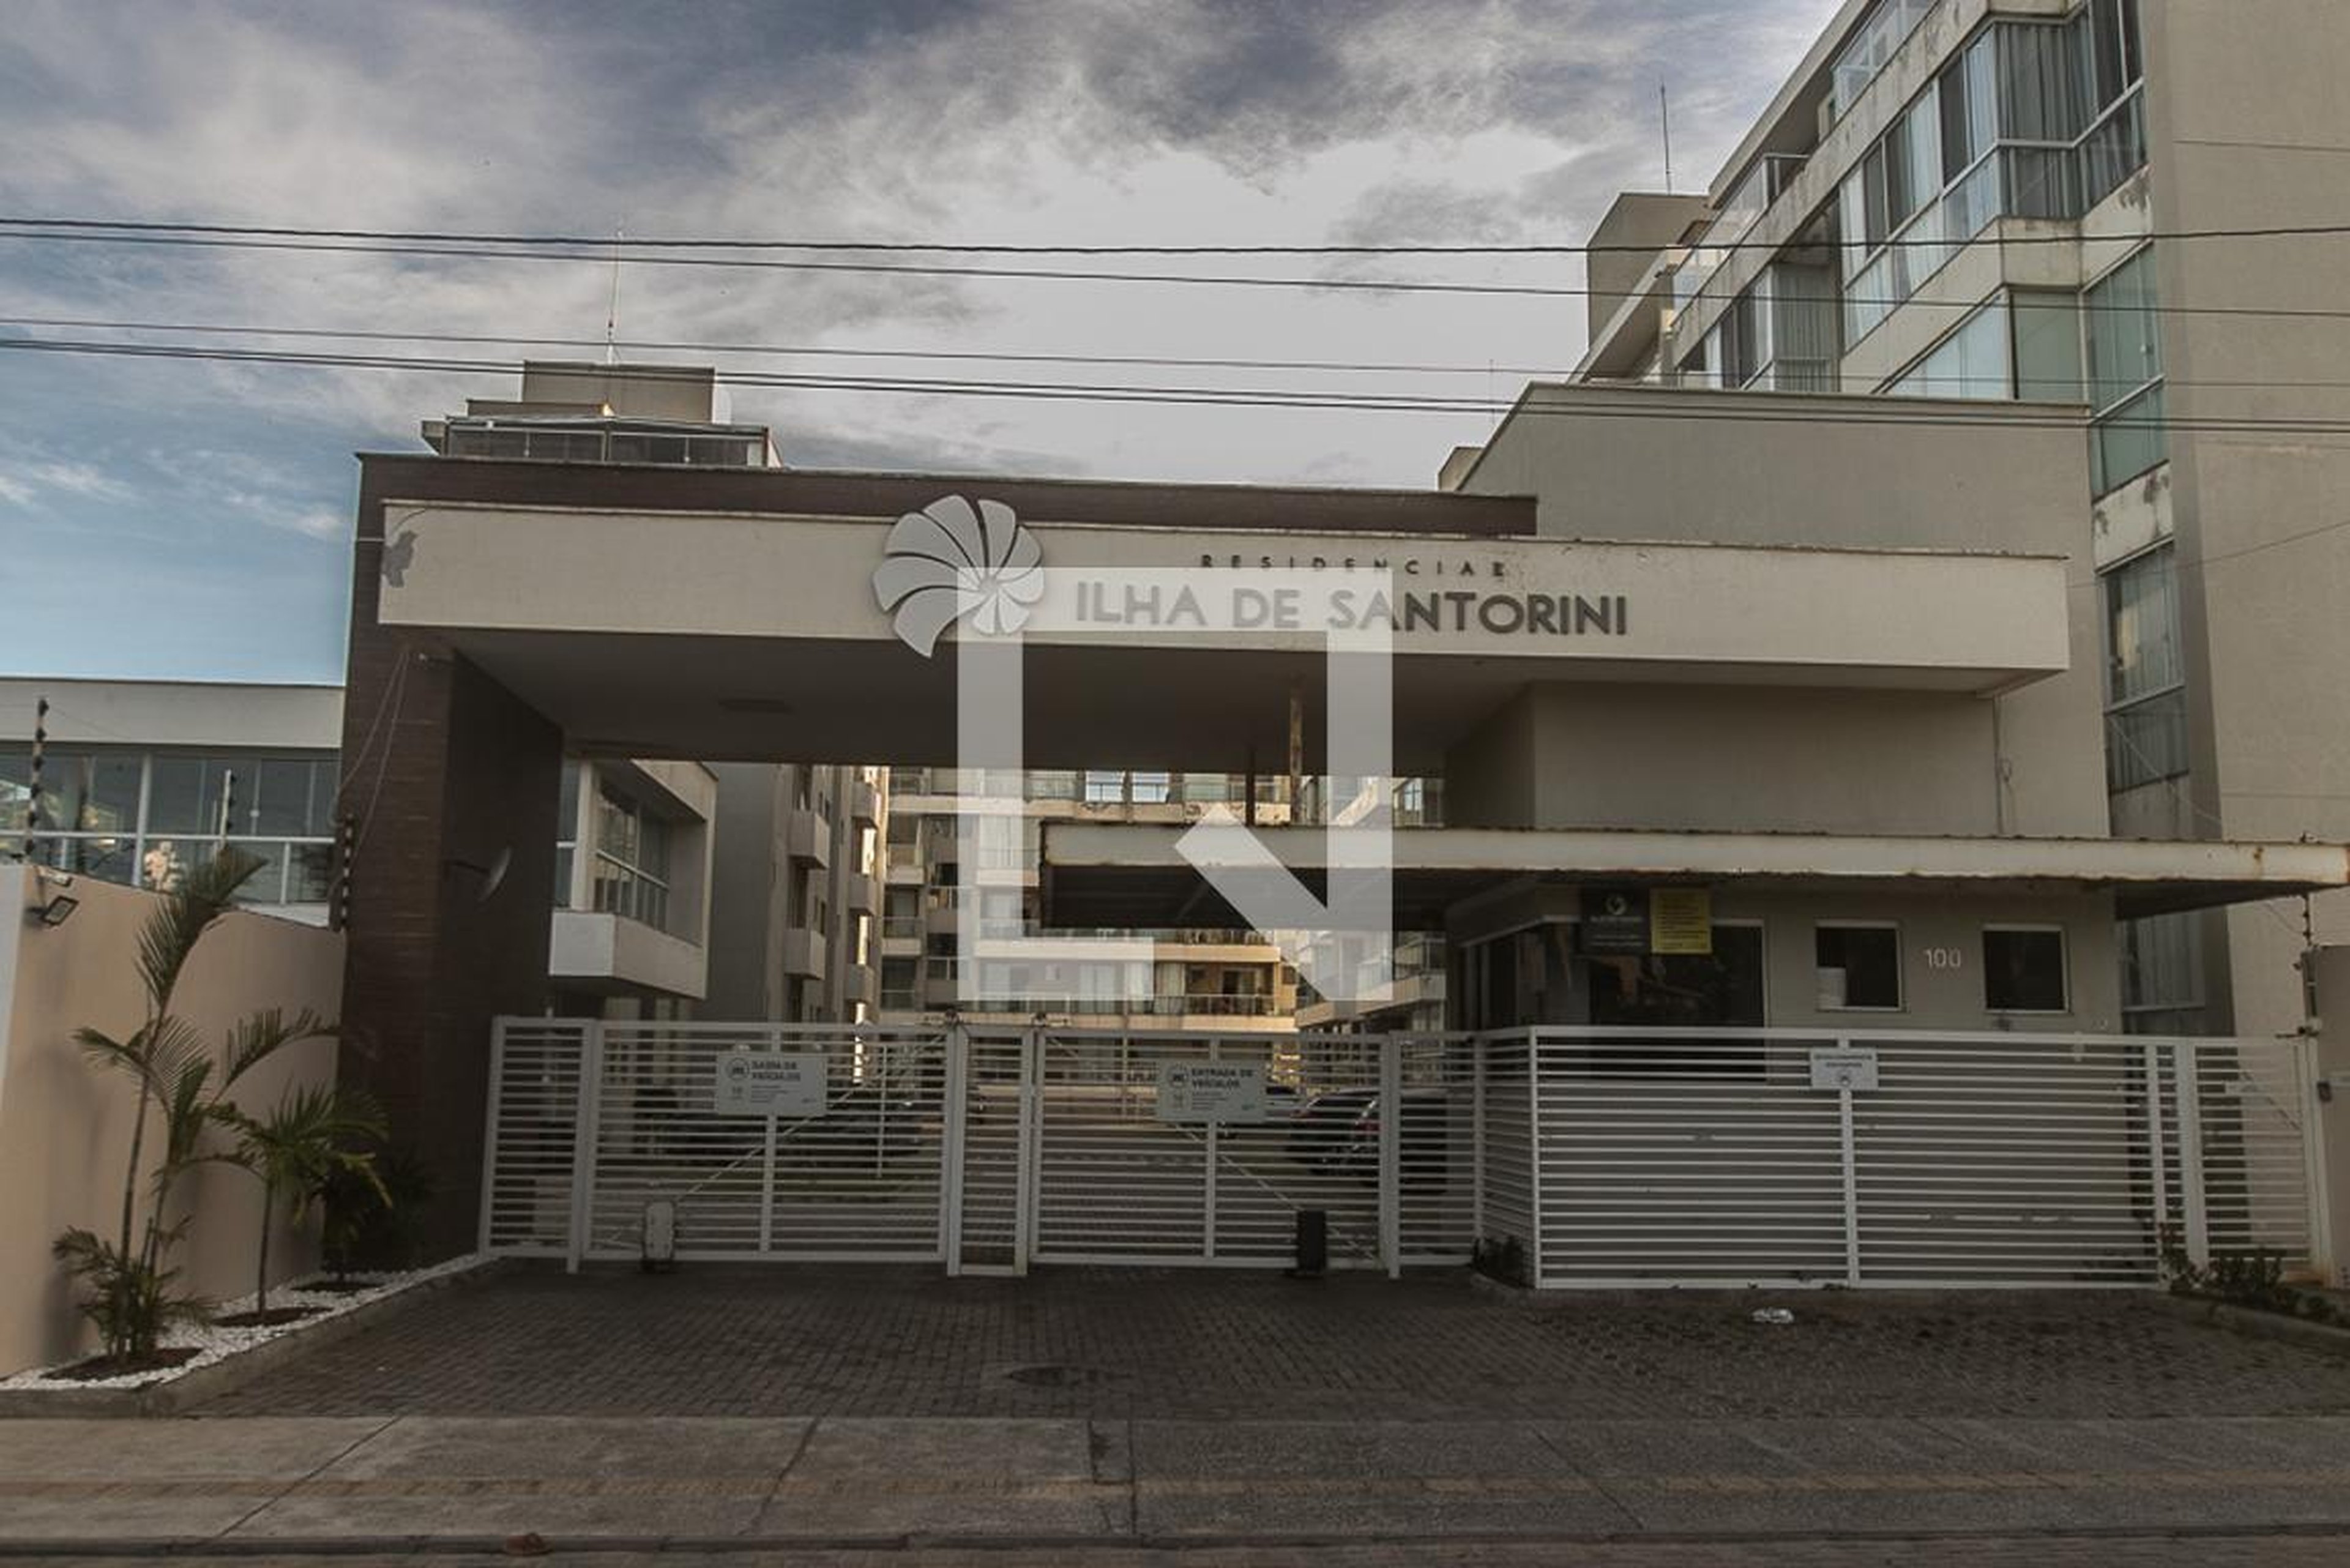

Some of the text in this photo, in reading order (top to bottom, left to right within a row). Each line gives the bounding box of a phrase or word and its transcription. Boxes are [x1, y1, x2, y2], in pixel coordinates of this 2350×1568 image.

[1076, 581, 1627, 635] ILHA DE SANTORINI
[1923, 947, 1961, 969] 100
[1192, 1068, 1236, 1077] ENTRADA
